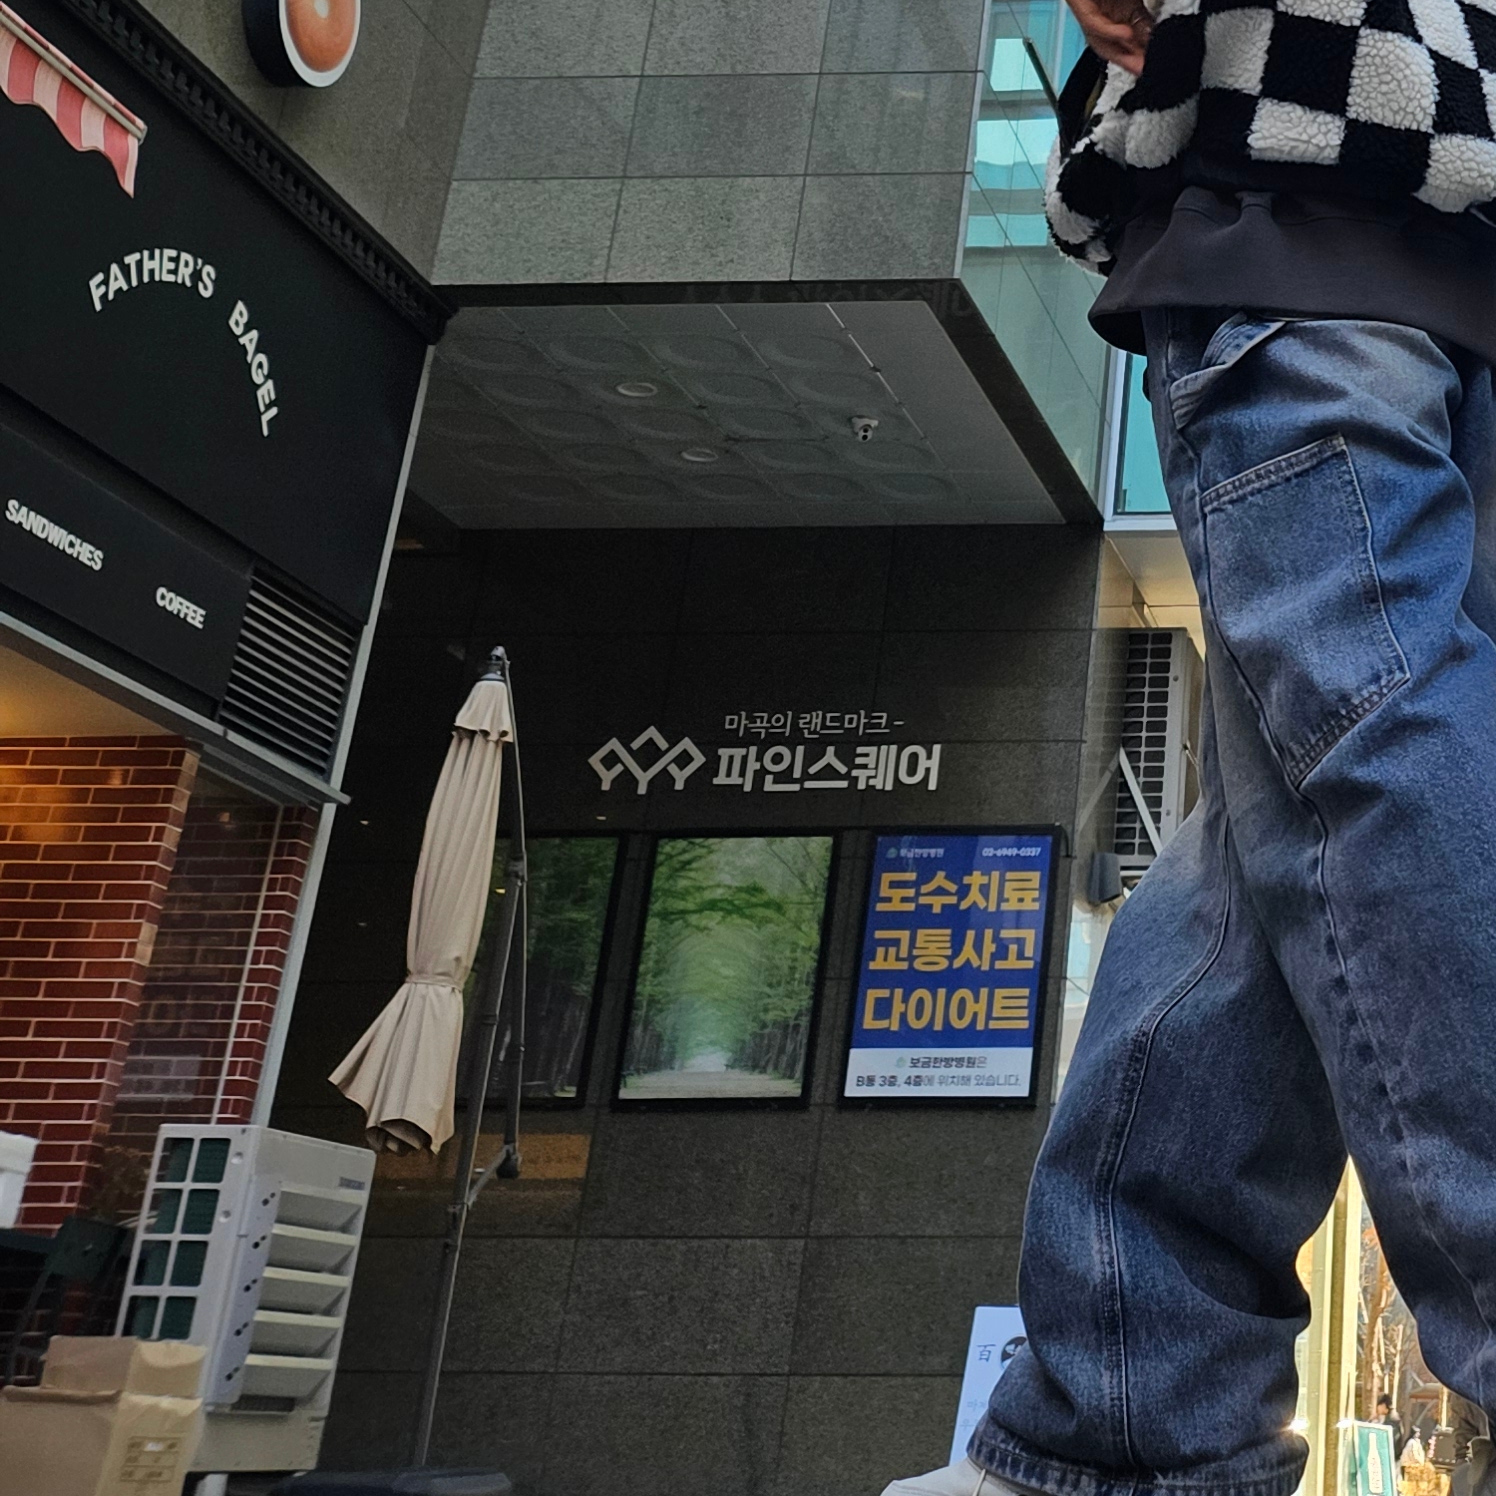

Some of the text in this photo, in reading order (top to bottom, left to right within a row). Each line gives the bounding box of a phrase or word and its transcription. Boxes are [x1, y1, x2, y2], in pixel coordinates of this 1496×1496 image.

[88, 248, 279, 438] FATHER'S BAGEL
[5, 499, 104, 571] SANDWICHES
[155, 586, 206, 629] COFFEE
[724, 710, 793, 740] 마곡의
[712, 743, 942, 792] 파인스퀘어
[875, 870, 1041, 914] 도수치료
[868, 928, 1036, 972] 교통사고
[862, 987, 1031, 1031] 다이어트
[856, 1075, 877, 1087] B동
[976, 1343, 997, 1363] 百
